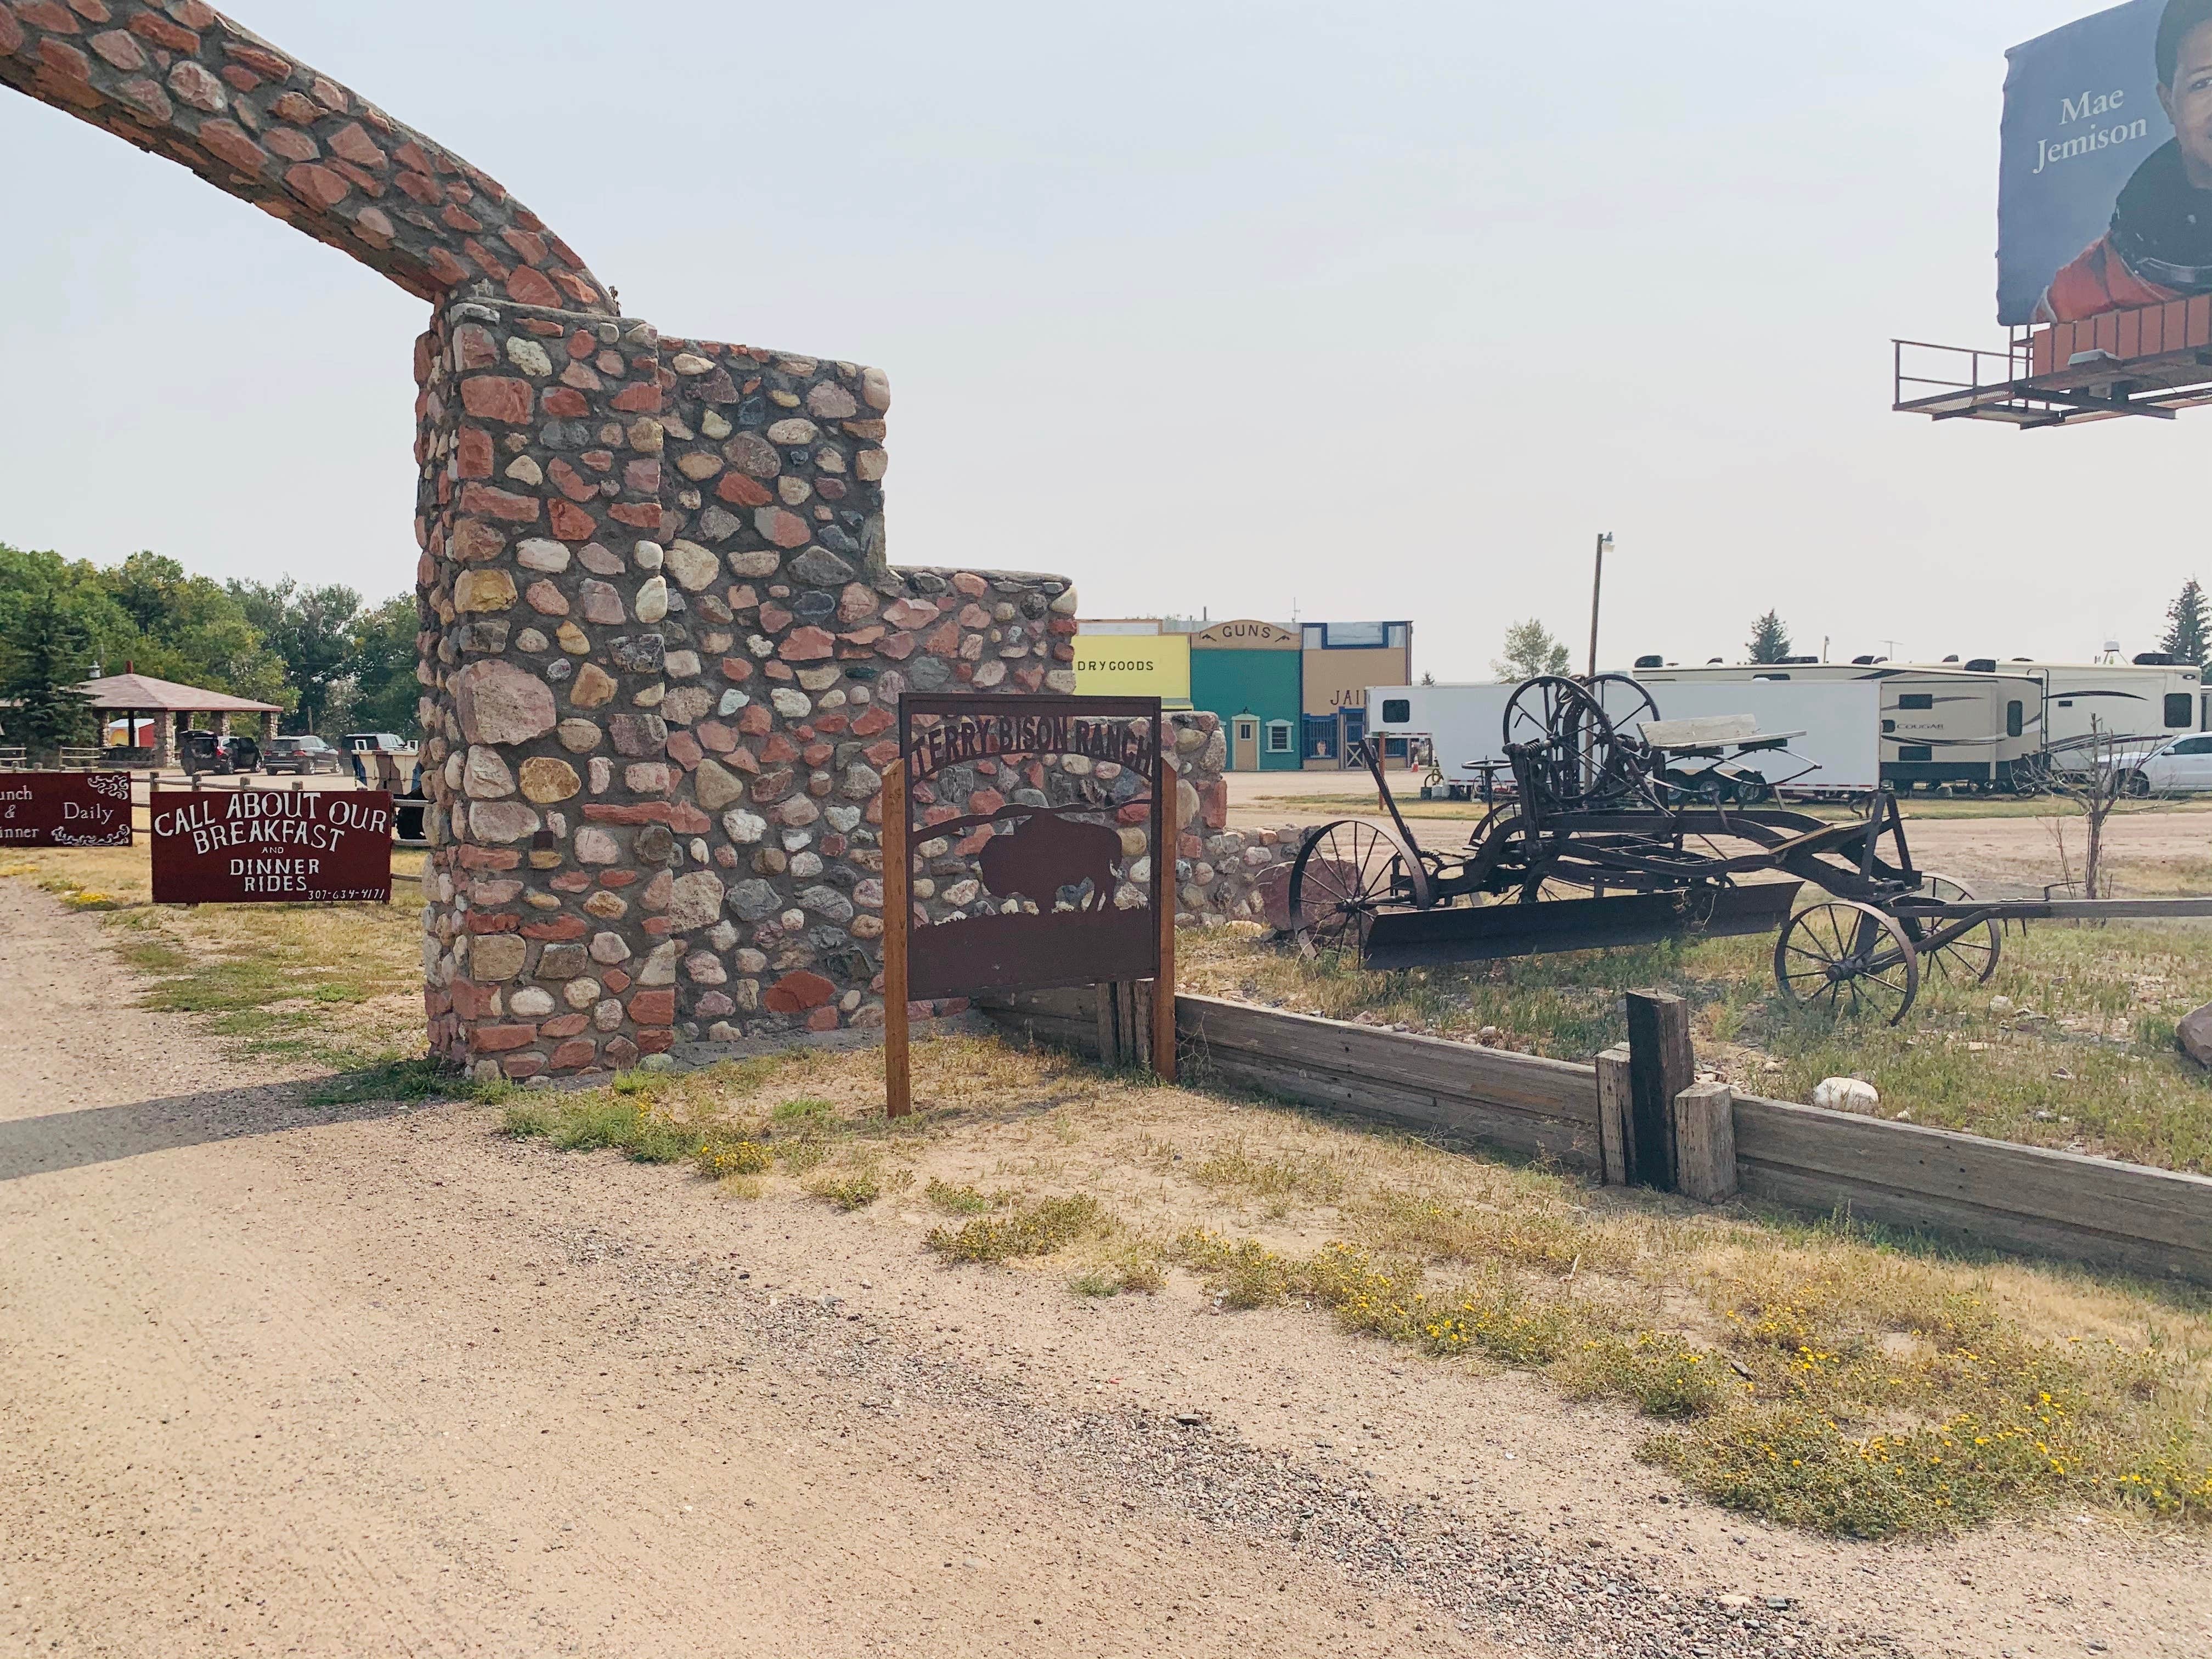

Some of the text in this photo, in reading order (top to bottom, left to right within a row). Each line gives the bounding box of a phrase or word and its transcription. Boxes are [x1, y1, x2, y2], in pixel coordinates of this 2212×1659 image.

[2059, 88, 2124, 126] Mae
[2033, 118, 2147, 174] Jemison
[1222, 624, 1271, 638] GUNS
[911, 715, 1153, 777] TERRY BISON RANCH
[4, 804, 16, 819] &
[63, 802, 114, 825] Daily
[154, 792, 387, 837] CALL ABOUT OUR
[193, 820, 345, 855] BREAKFAST
[230, 859, 319, 876] DINNER
[244, 876, 307, 892] RIDES
[308, 889, 385, 900] 307-634-4171
